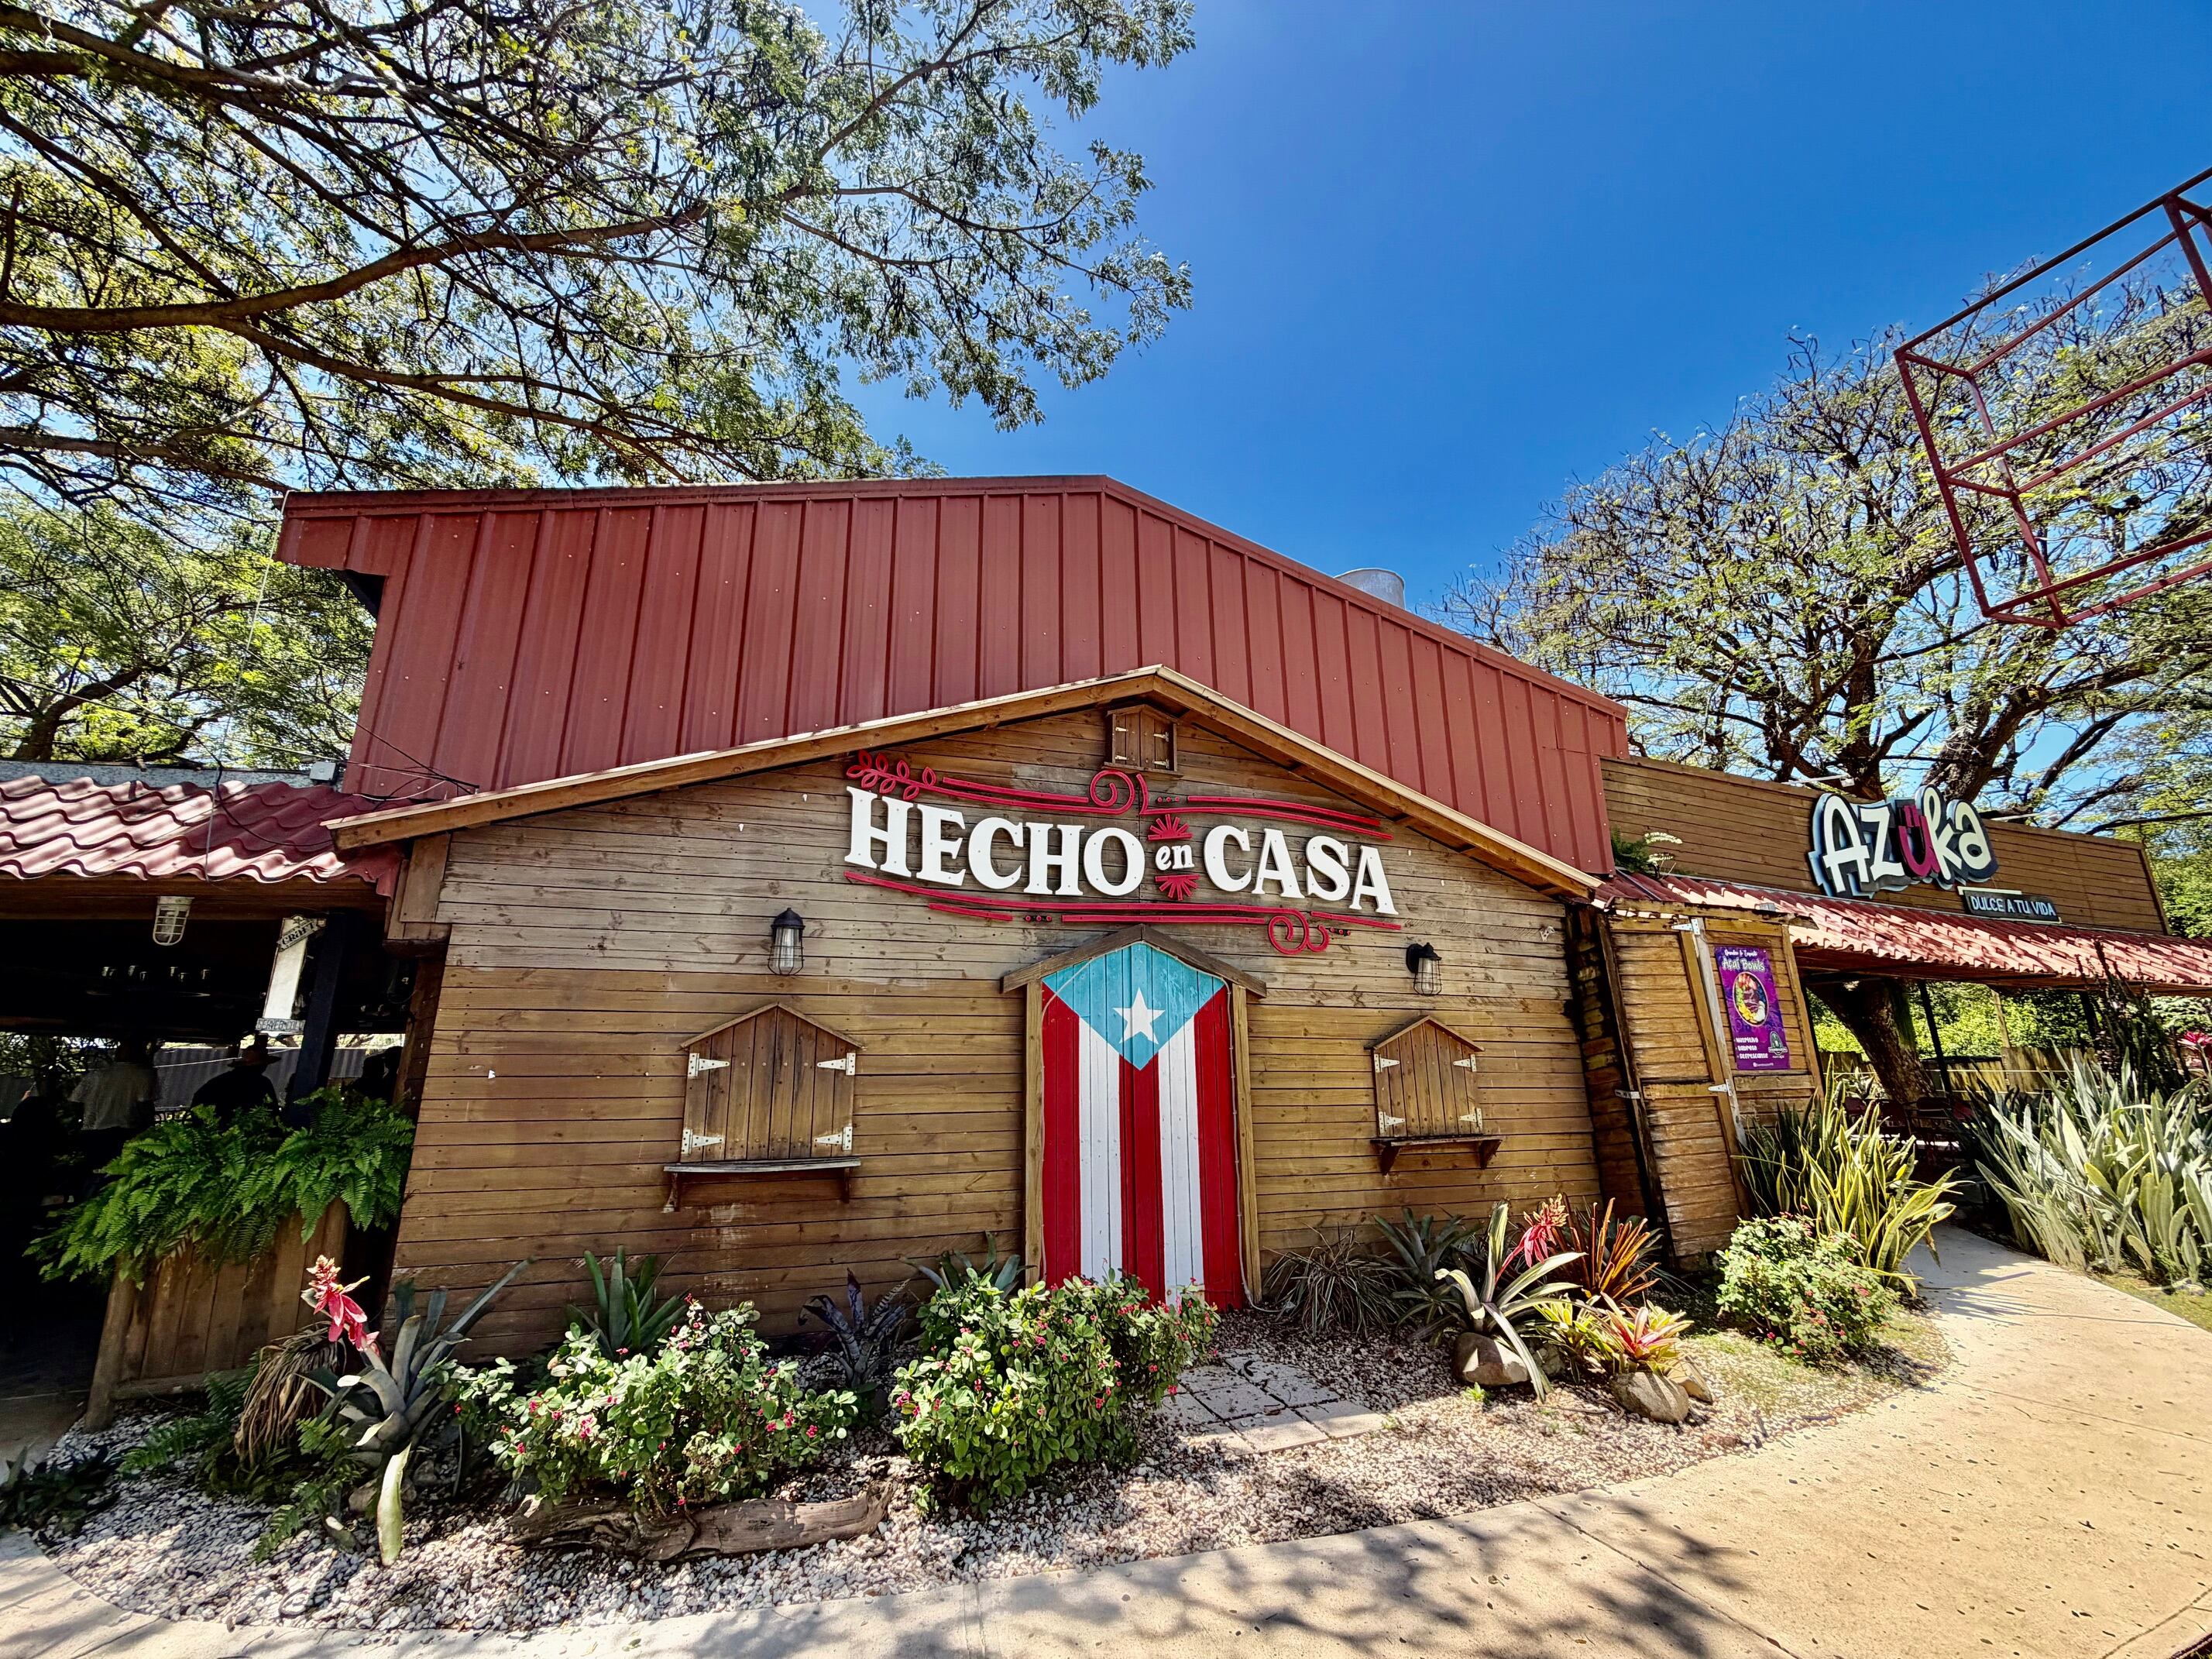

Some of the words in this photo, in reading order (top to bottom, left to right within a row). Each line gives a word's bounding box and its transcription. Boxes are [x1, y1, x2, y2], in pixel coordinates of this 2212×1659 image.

[843, 786, 1146, 896] HECHO
[1156, 843, 1195, 871] en
[1204, 825, 1399, 915] CASA
[1970, 895, 2005, 912] DULCE
[2007, 899, 2015, 913] A
[2014, 899, 2031, 914] TU
[2032, 901, 2057, 916] VIDA
